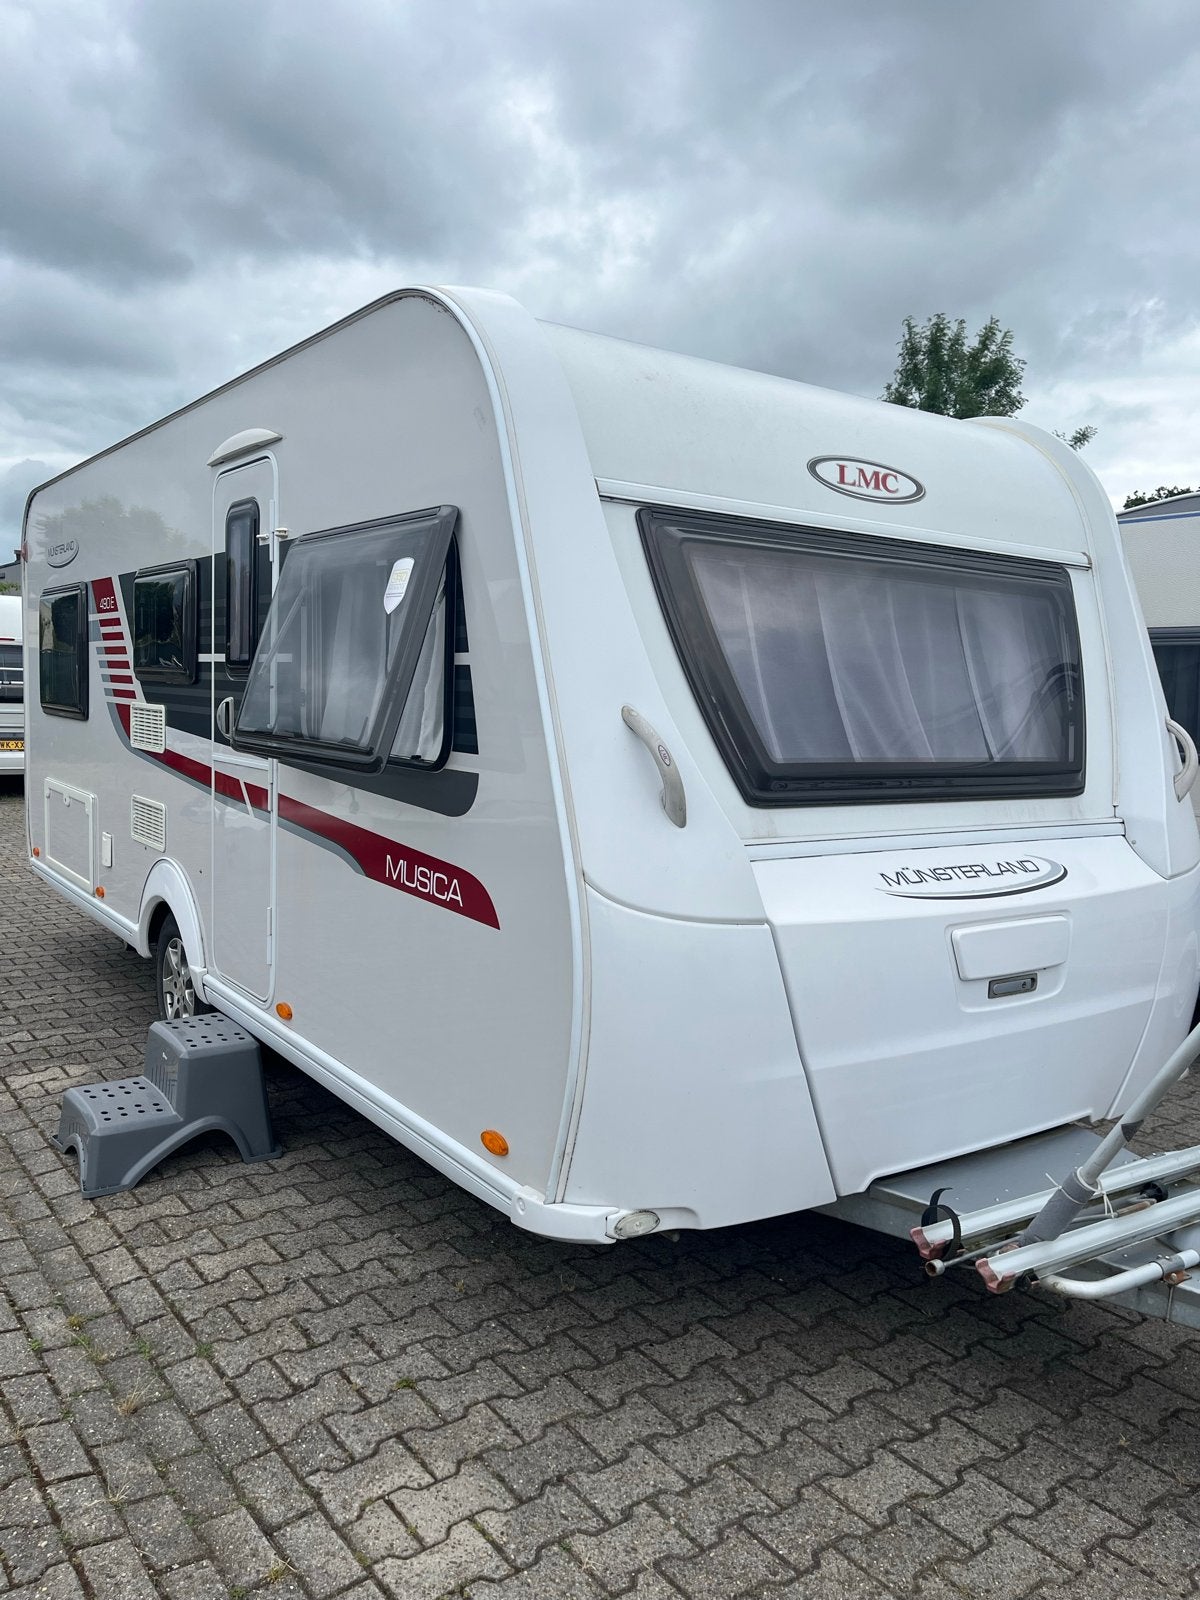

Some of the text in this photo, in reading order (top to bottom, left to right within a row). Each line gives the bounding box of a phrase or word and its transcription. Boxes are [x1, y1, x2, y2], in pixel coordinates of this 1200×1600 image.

[836, 463, 899, 494] LMC
[100, 597, 115, 609] 490E
[385, 854, 464, 907] MUSICA
[879, 859, 1040, 887] MÜNSTERLAND
